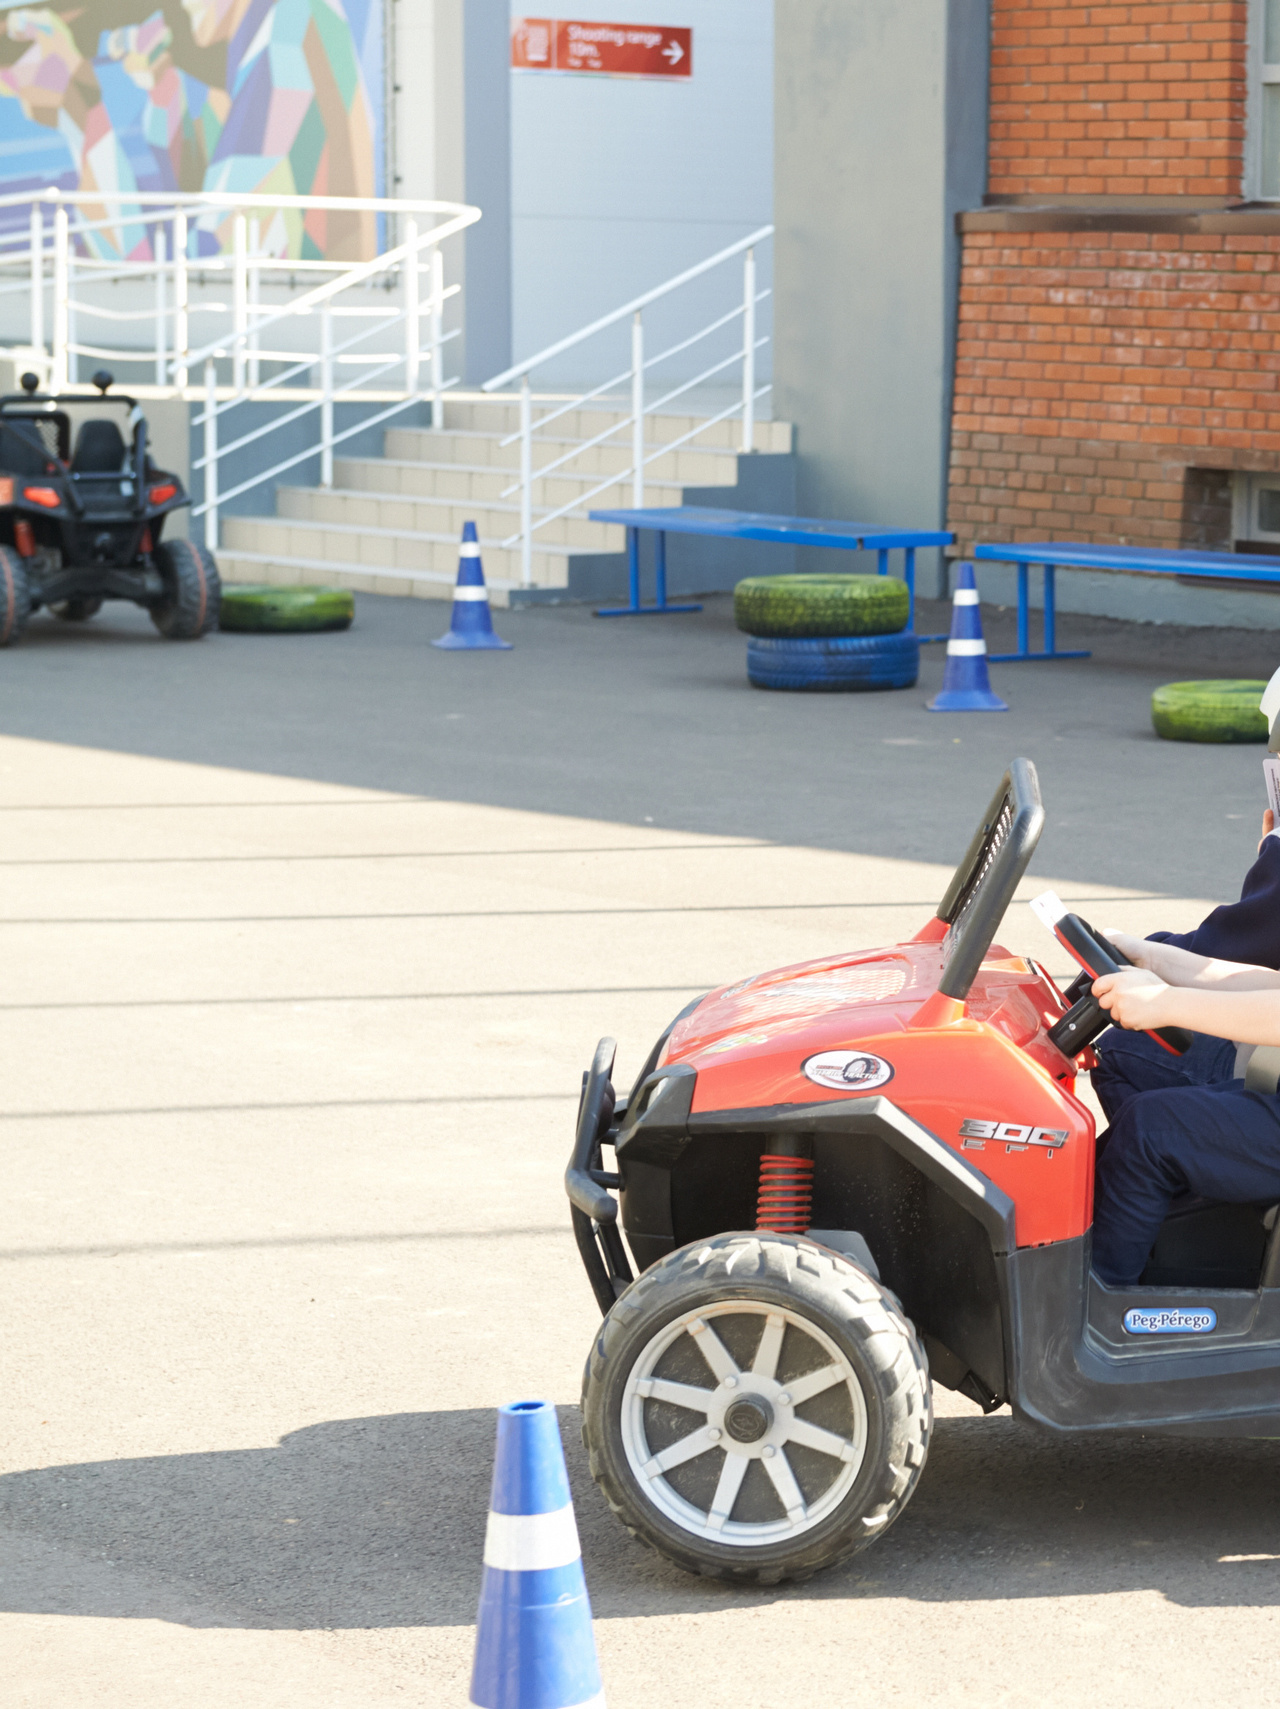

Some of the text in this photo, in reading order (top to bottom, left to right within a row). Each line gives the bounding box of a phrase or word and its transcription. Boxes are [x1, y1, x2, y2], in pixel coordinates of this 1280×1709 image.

[567, 24, 663, 48] Shooting range
[958, 1118, 1069, 1148] 800
